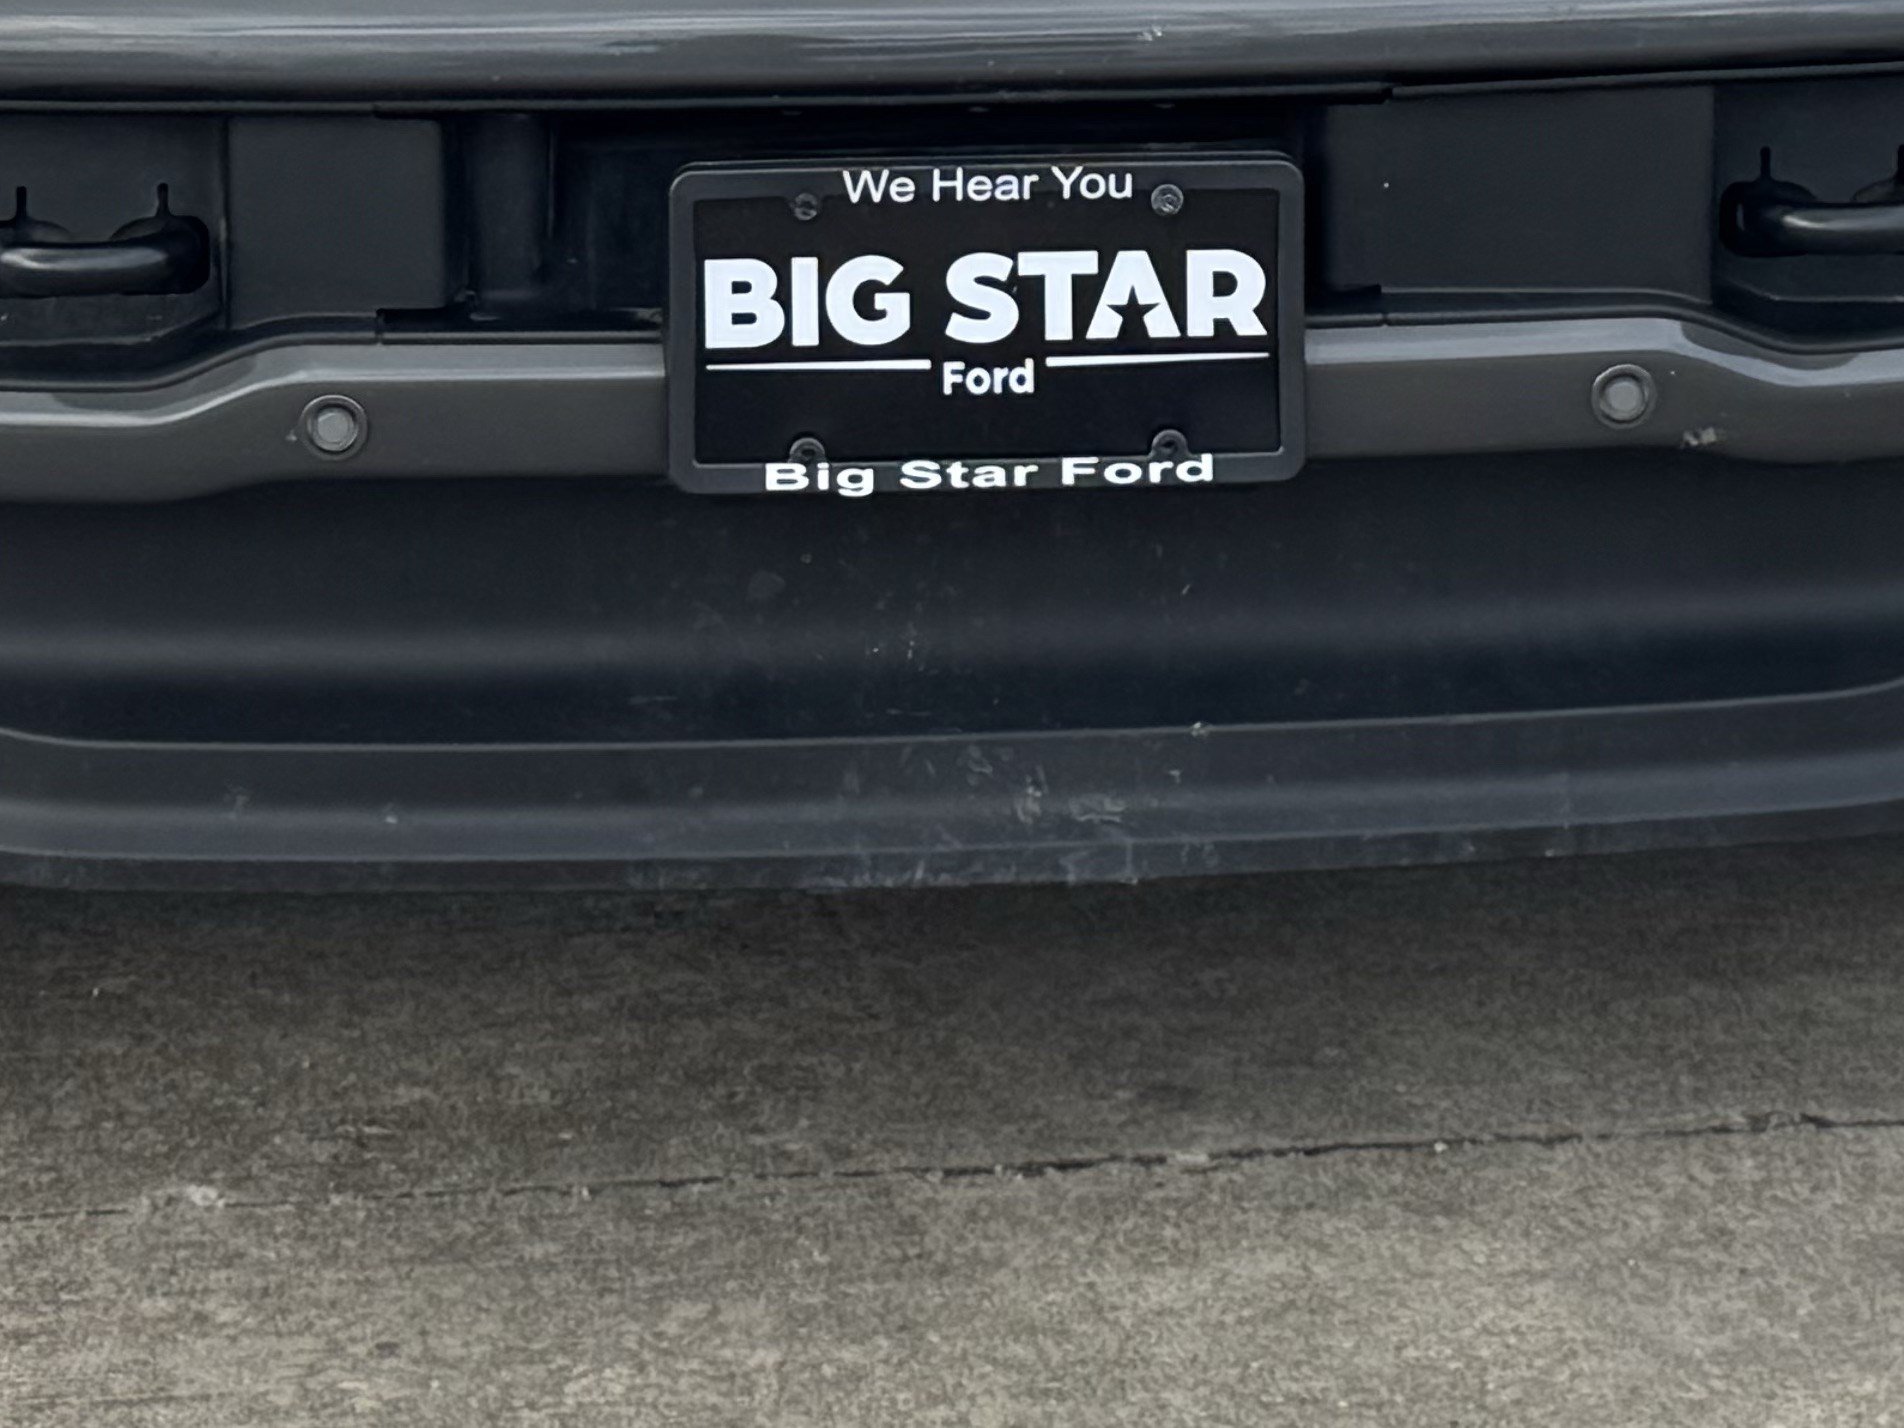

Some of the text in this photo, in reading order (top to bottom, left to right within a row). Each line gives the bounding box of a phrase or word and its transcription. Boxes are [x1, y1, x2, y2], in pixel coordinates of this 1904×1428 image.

[842, 165, 1133, 204] We Hear You
[703, 249, 1268, 350] BIG STAR
[942, 357, 1035, 396] Ford
[764, 453, 1214, 498] Big Star Ford
